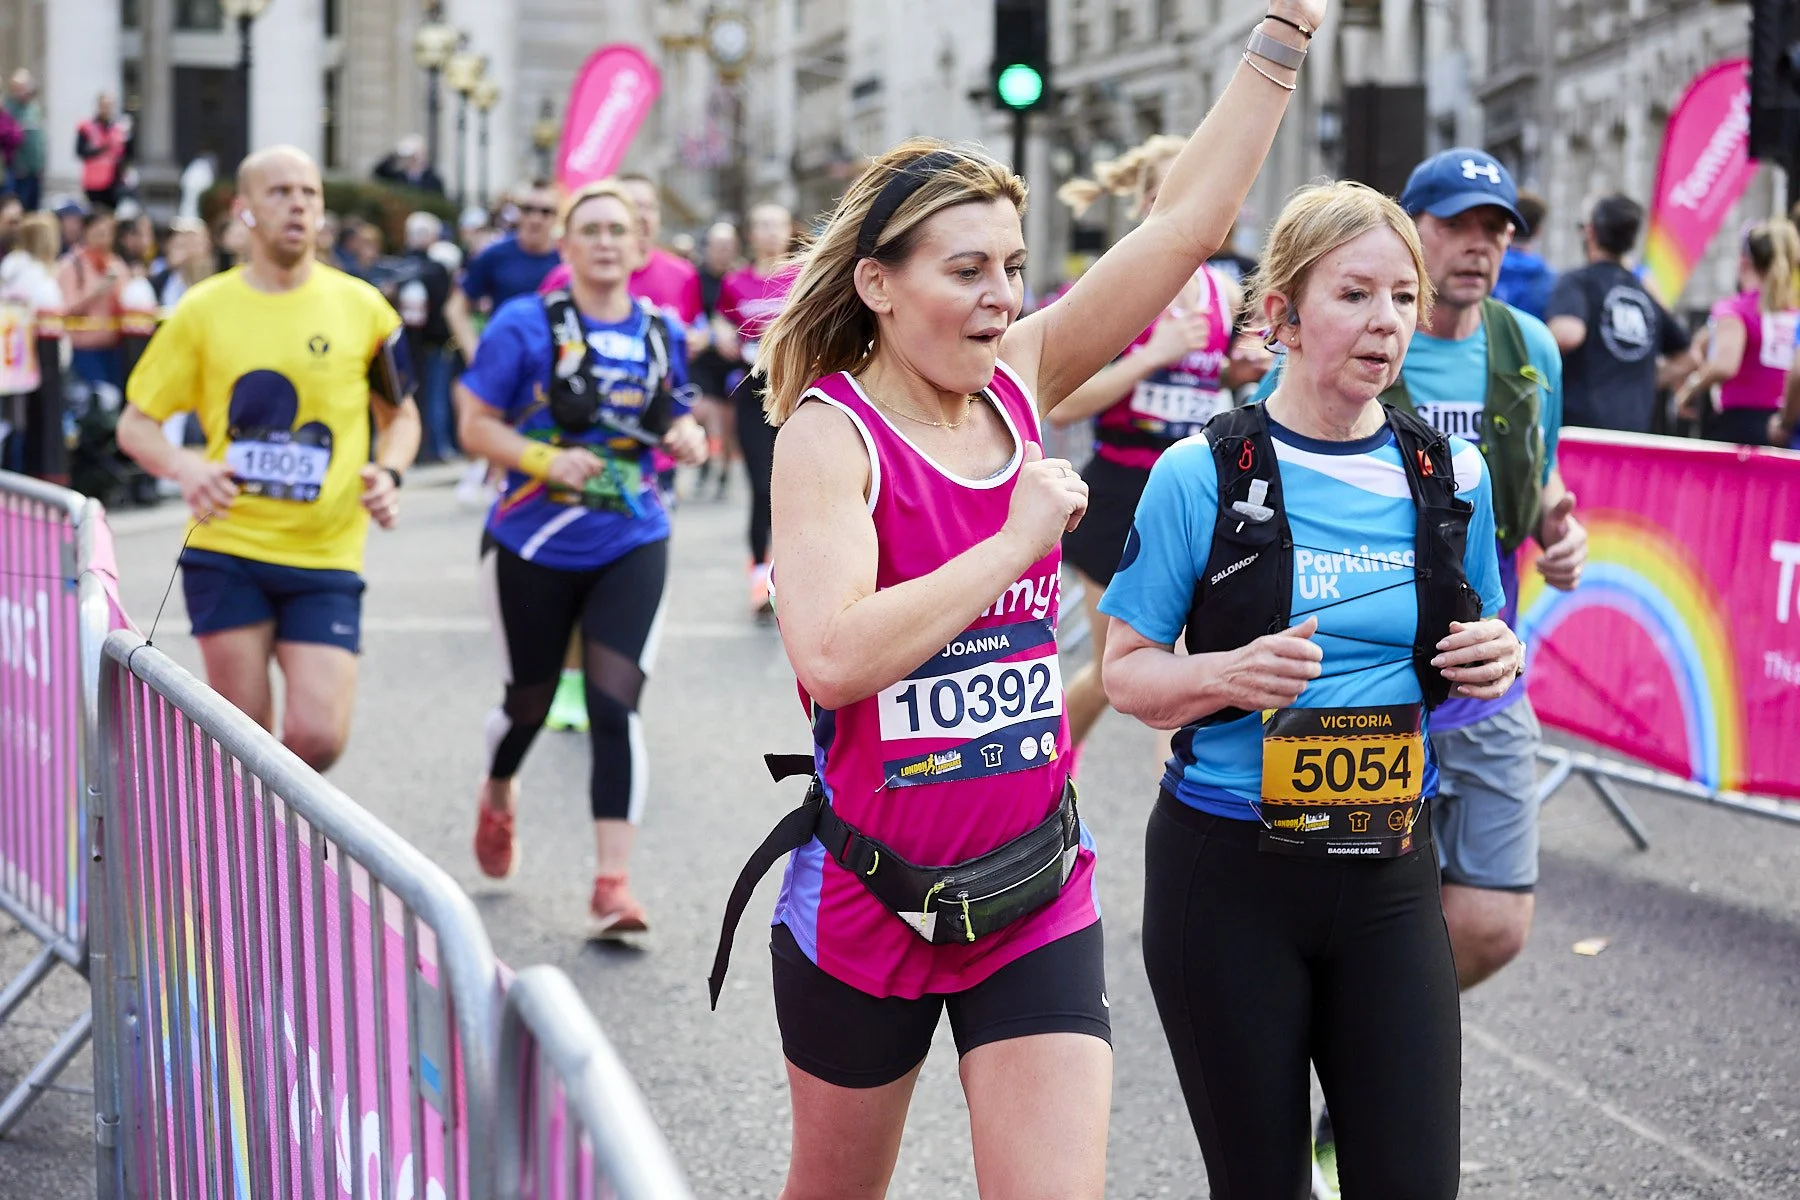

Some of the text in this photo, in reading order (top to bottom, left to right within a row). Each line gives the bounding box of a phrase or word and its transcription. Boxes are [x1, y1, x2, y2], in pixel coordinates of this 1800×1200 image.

[244, 450, 314, 479] 1805
[1211, 553, 1259, 585] SALOMON
[1770, 539, 1800, 624] T
[1299, 574, 1341, 600] UK
[941, 634, 1010, 658] JOANNA
[896, 663, 1054, 732] 10392
[1320, 714, 1393, 728] VICTORIA
[901, 761, 928, 777] LONDON
[1291, 746, 1411, 793] 5054
[1274, 820, 1299, 828] LONDON
[1327, 847, 1381, 855] BAGGAGE LABEL
